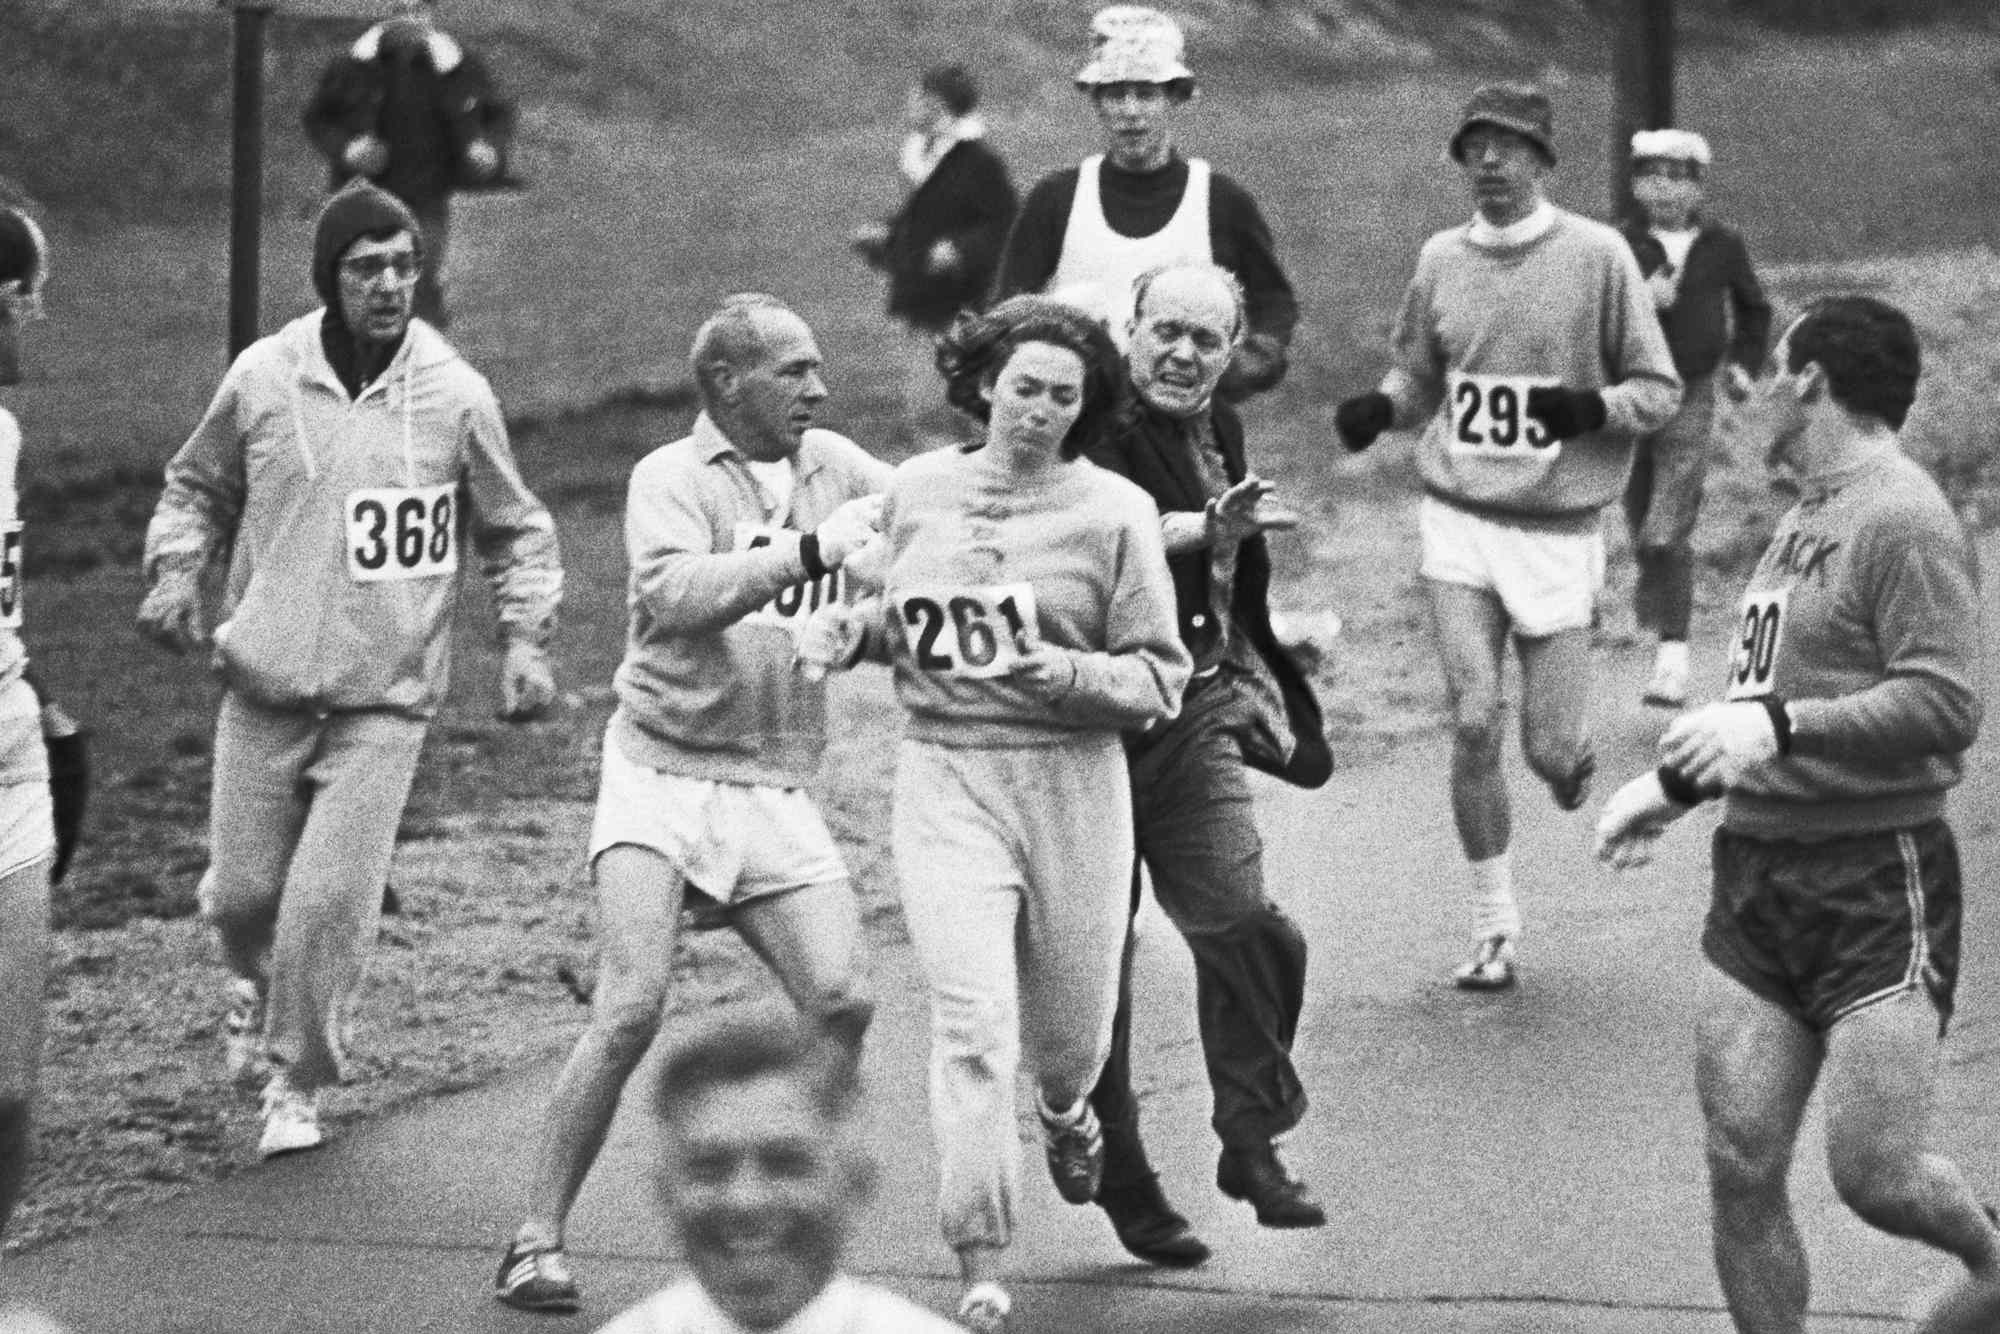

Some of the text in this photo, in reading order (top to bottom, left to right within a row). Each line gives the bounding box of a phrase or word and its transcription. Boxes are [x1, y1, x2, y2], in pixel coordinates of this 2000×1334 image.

[1456, 381, 1554, 448] 295
[354, 494, 450, 569] 368
[1770, 530, 1840, 587] ACK
[904, 595, 1030, 670] 261
[1731, 602, 1780, 684] 90
